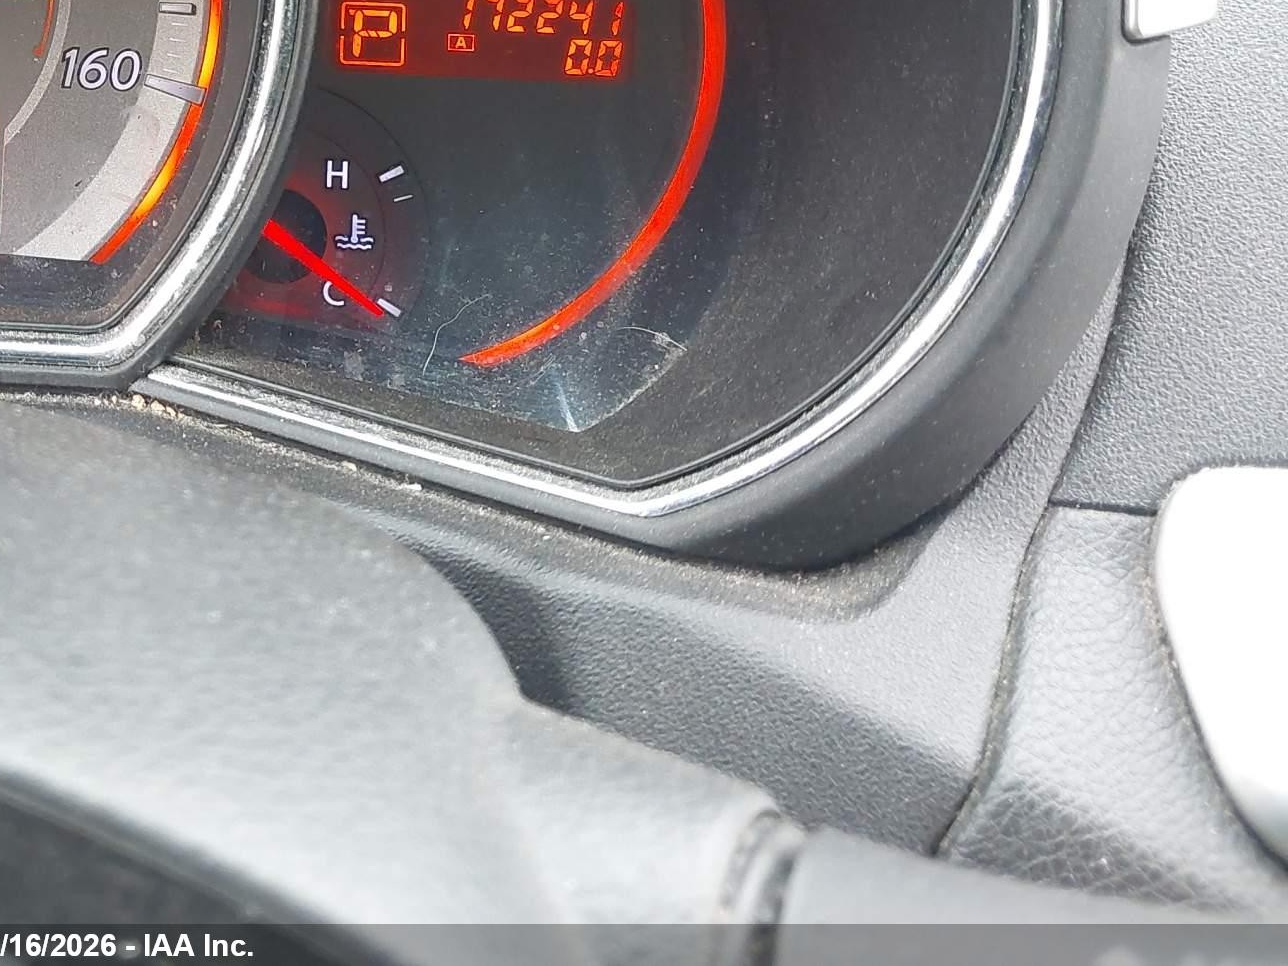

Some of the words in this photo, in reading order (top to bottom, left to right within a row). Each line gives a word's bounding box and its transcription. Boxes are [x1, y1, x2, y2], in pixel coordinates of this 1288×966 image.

[349, 10, 398, 57] P
[63, 48, 141, 91] 160
[565, 39, 623, 76] 0.0
[326, 160, 350, 188] H
[323, 281, 346, 306] C
